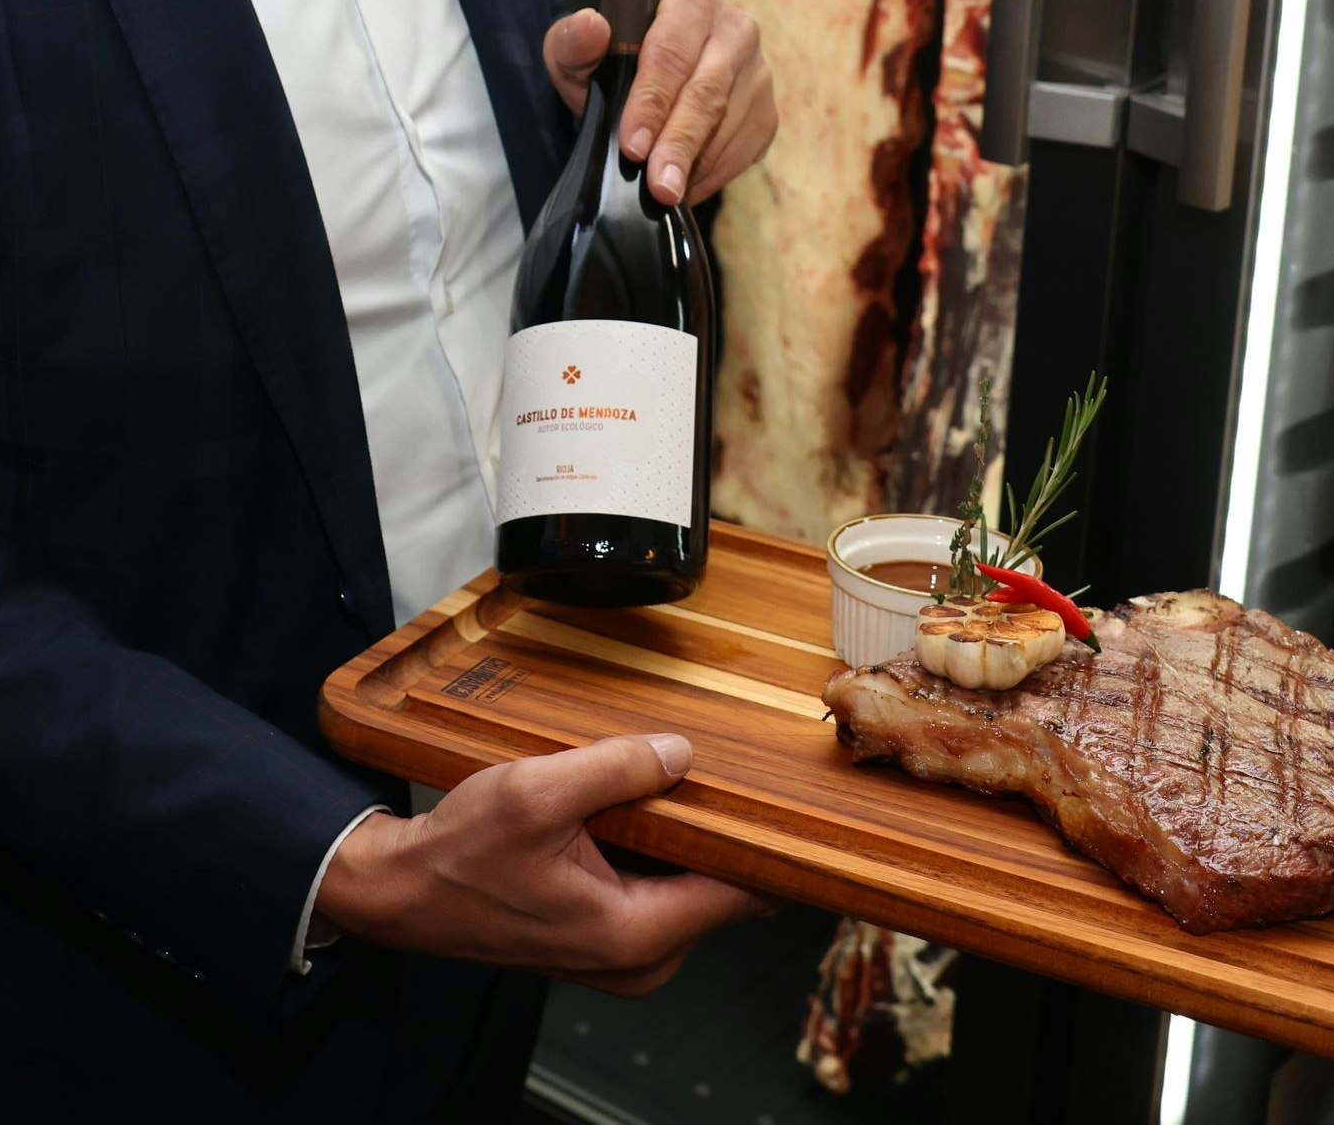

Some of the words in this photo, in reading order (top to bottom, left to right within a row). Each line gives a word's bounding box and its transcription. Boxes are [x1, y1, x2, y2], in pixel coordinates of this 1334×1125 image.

[516, 408, 557, 426] CASTILLO
[561, 407, 575, 419] DE
[578, 406, 637, 421] MENDOZA
[537, 422, 559, 433] AUTOR
